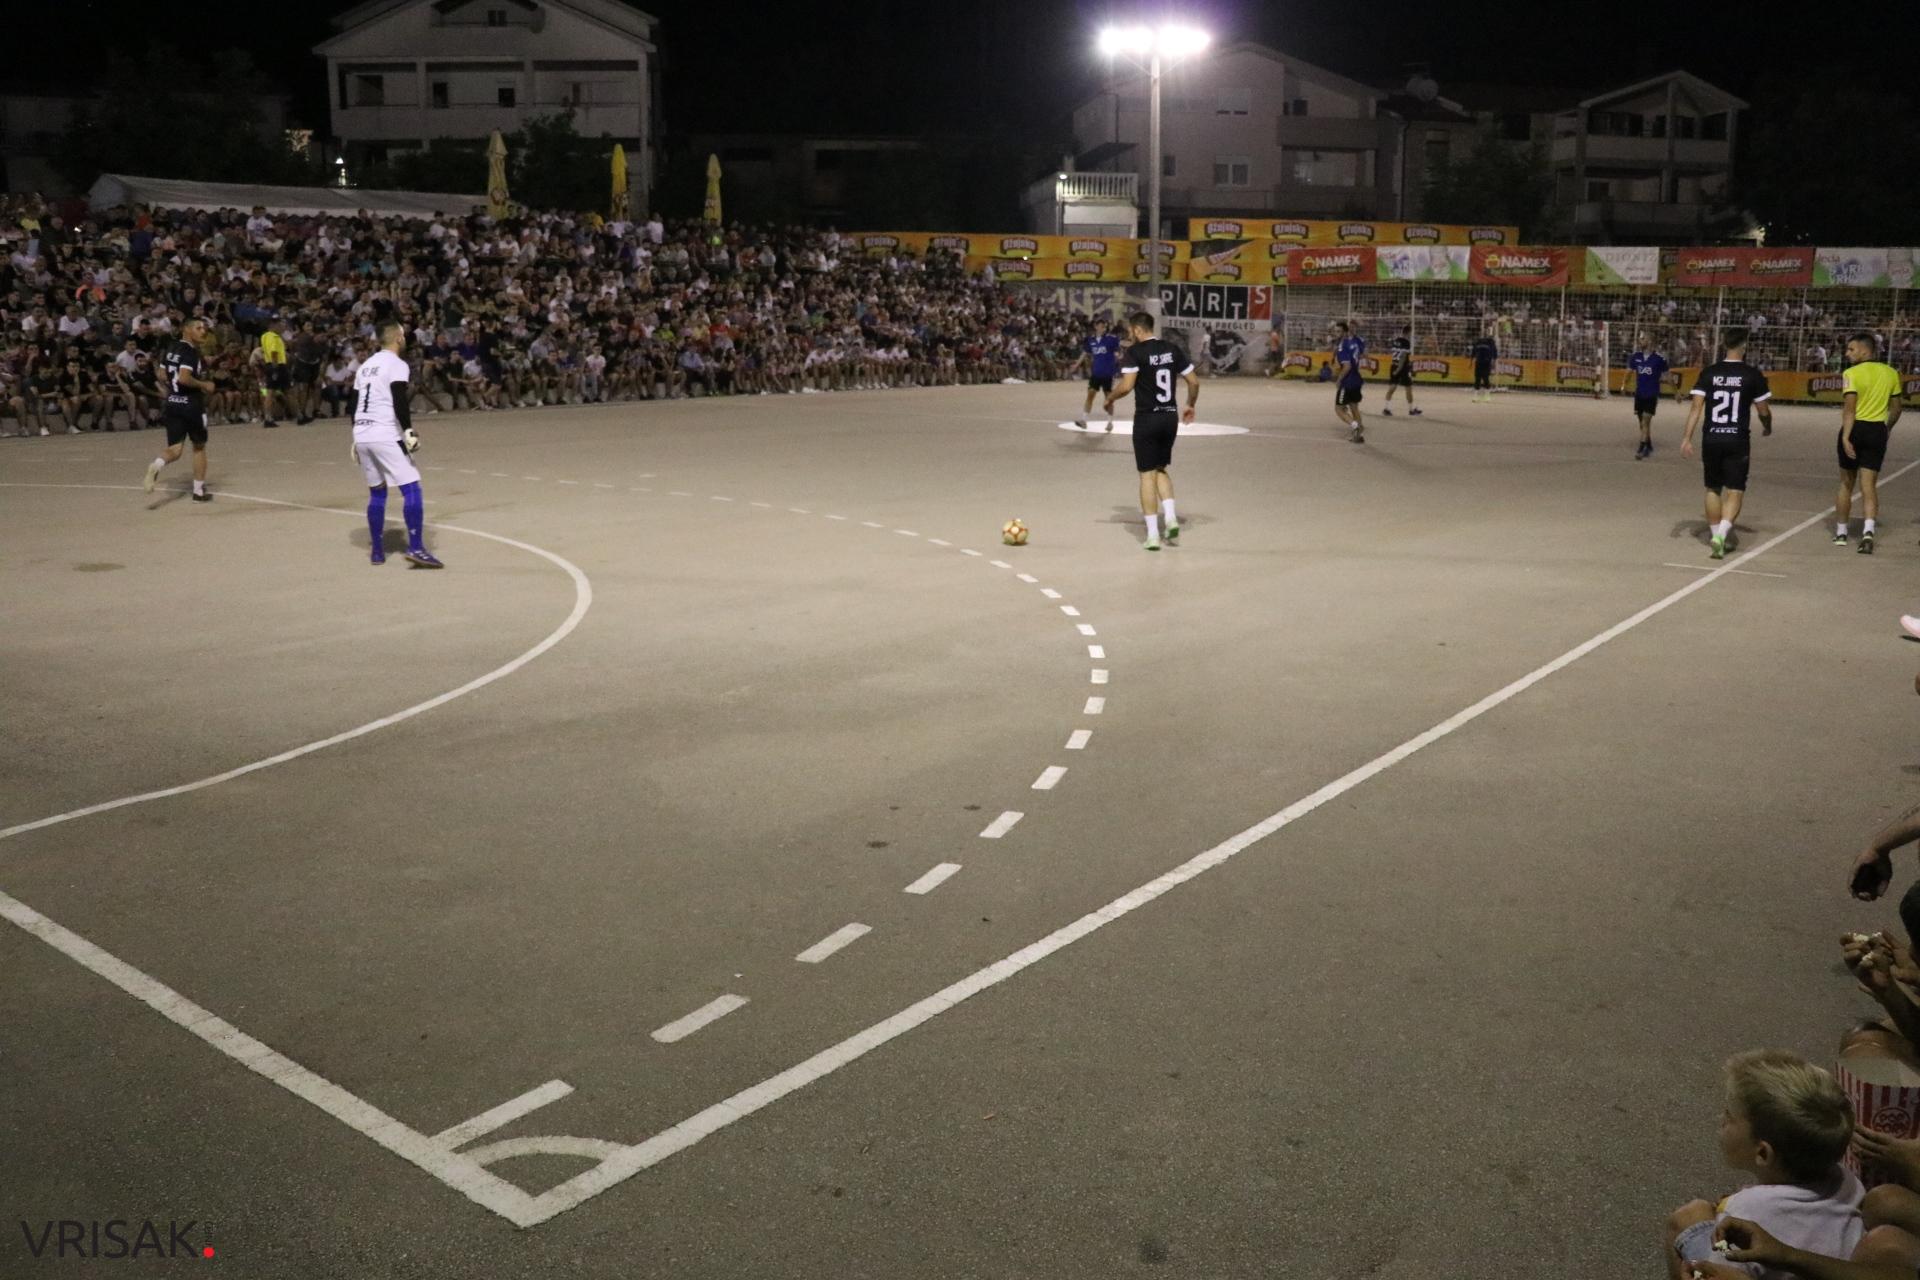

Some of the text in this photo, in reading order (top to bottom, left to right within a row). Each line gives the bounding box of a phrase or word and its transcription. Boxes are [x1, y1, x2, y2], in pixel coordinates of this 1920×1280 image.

[1315, 255, 1361, 269] NAMEX
[1501, 256, 1551, 268] NAMEX
[363, 382, 372, 414] 1
[1156, 368, 1172, 403] 9
[1712, 390, 1740, 424] 21
